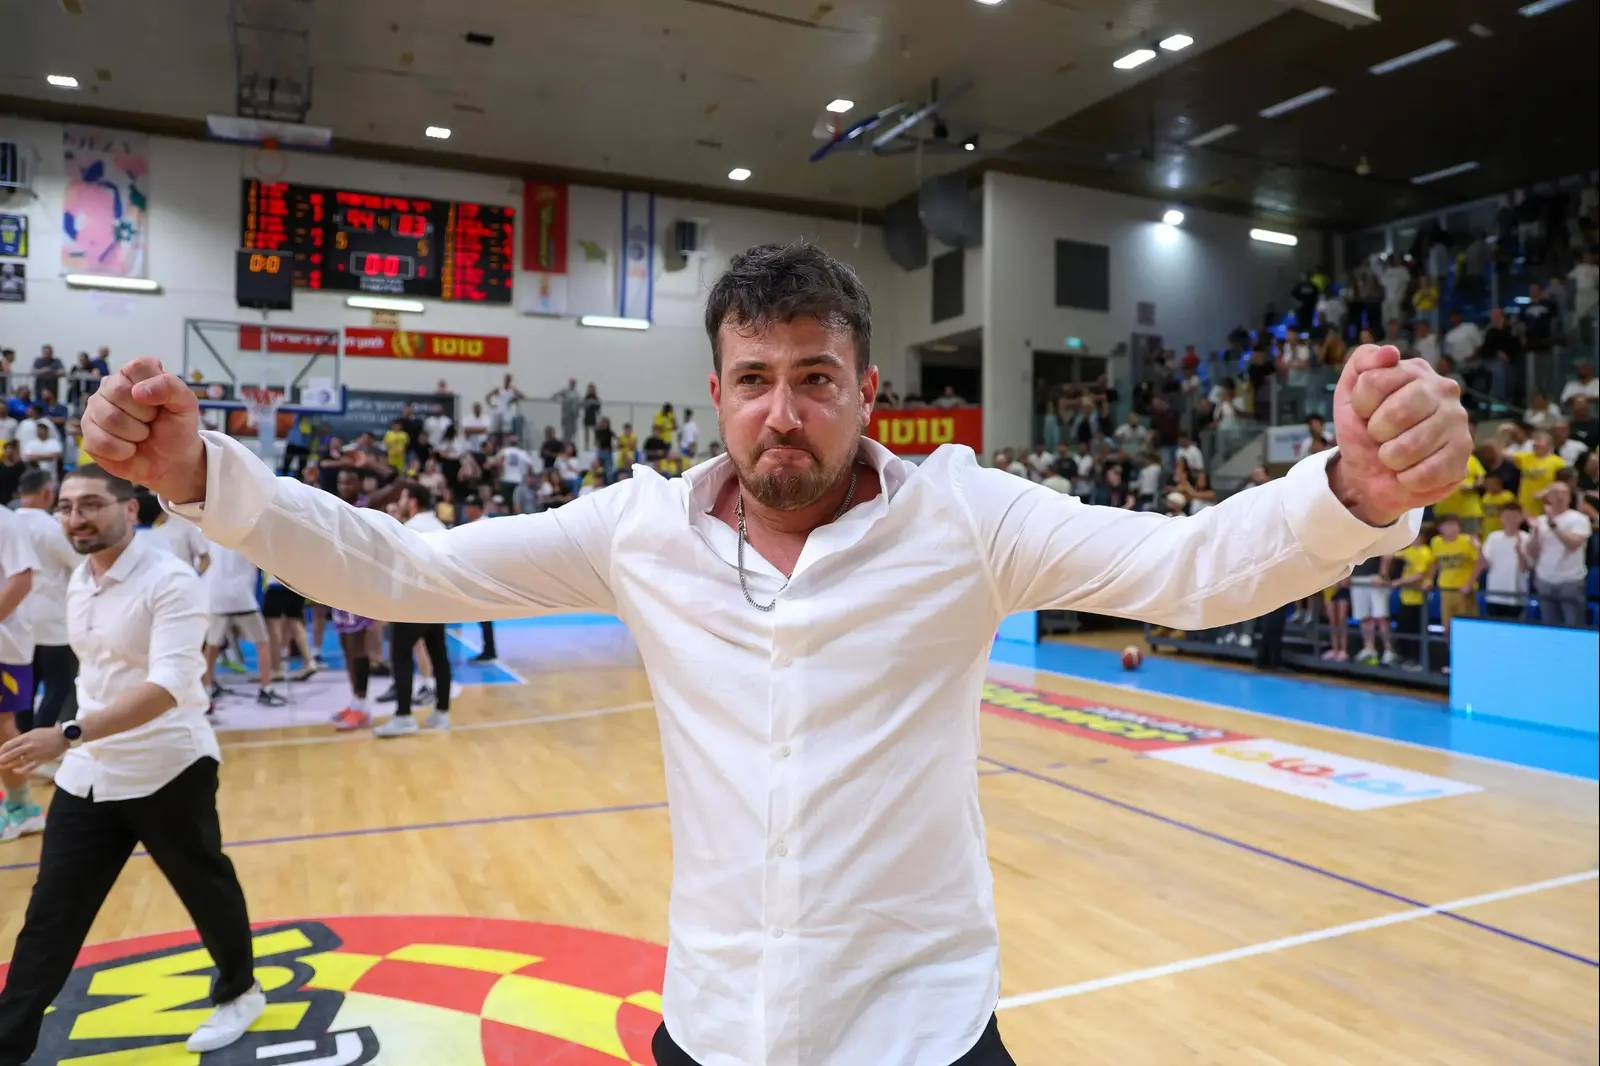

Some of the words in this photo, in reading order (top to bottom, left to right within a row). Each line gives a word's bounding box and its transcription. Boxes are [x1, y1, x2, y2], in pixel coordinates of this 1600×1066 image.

[347, 209, 375, 231] 94
[432, 337, 484, 357] טוטו
[878, 417, 955, 445] טוטו
